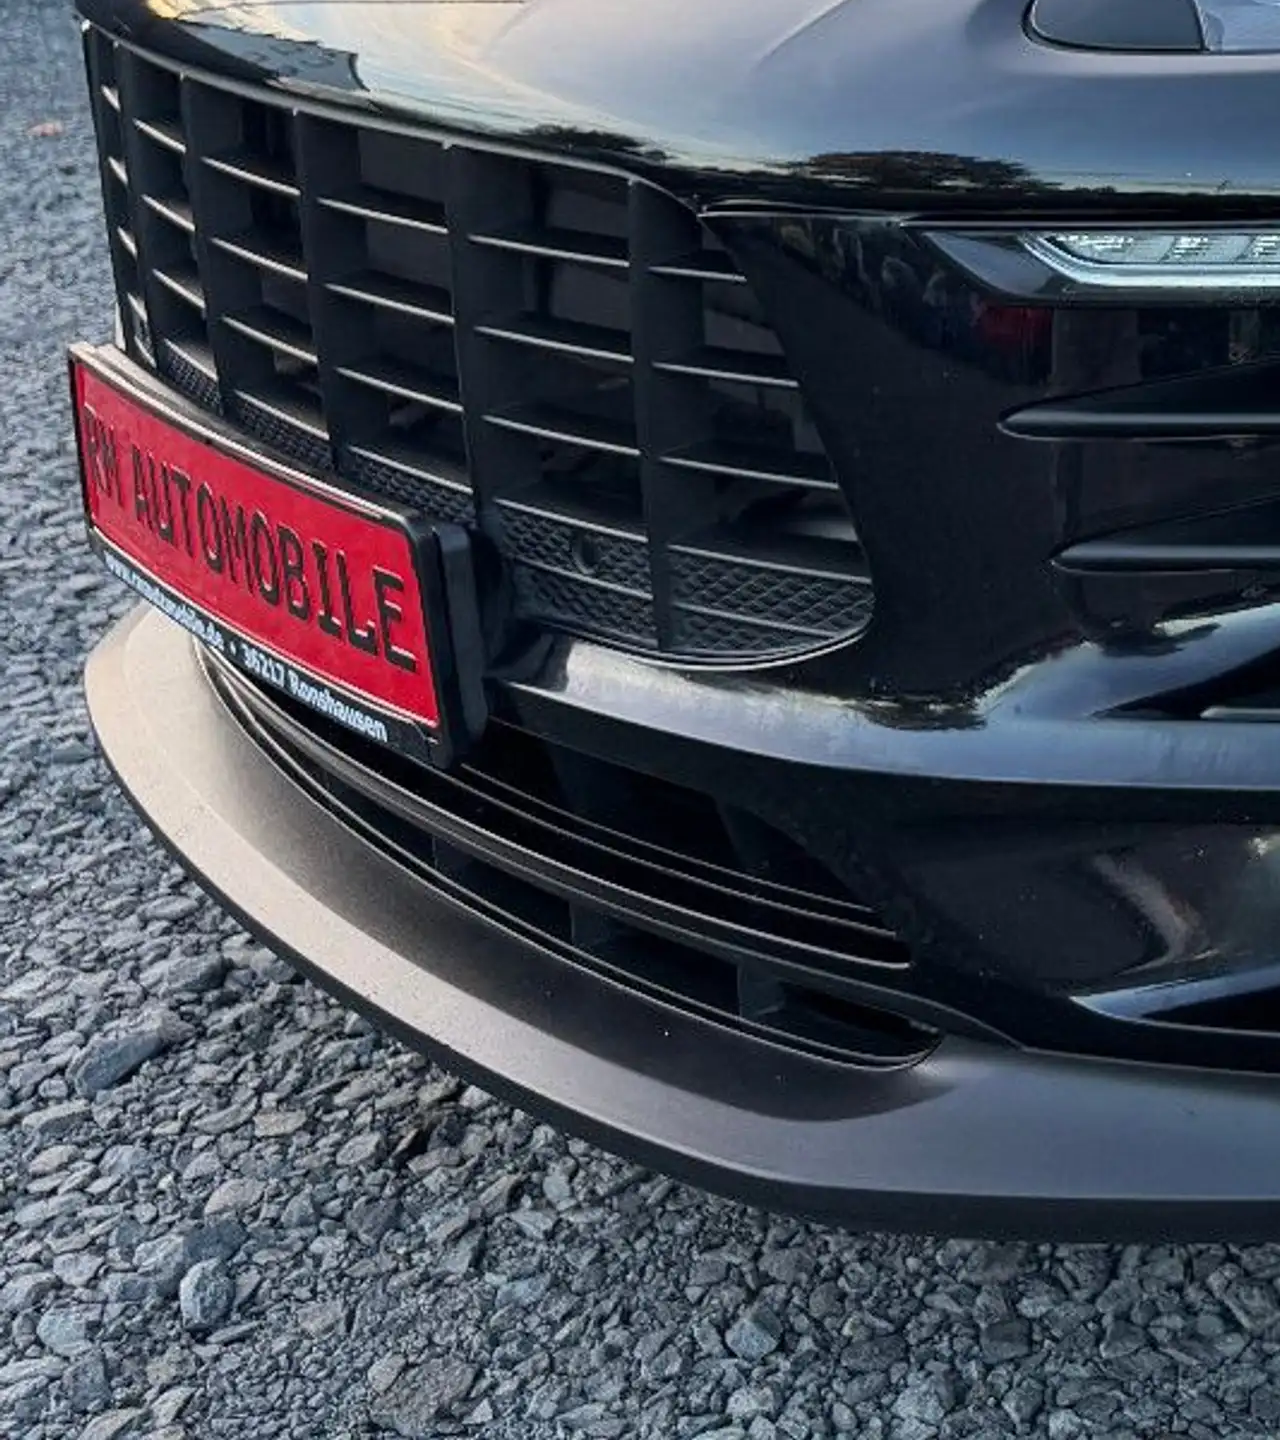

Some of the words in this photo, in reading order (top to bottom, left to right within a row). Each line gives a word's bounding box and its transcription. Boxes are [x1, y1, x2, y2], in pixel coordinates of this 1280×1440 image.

[83, 402, 124, 510] RM
[130, 442, 417, 673] AUTOMOBILE
[241, 643, 285, 688] 36217
[287, 669, 388, 743] Ronshausen
